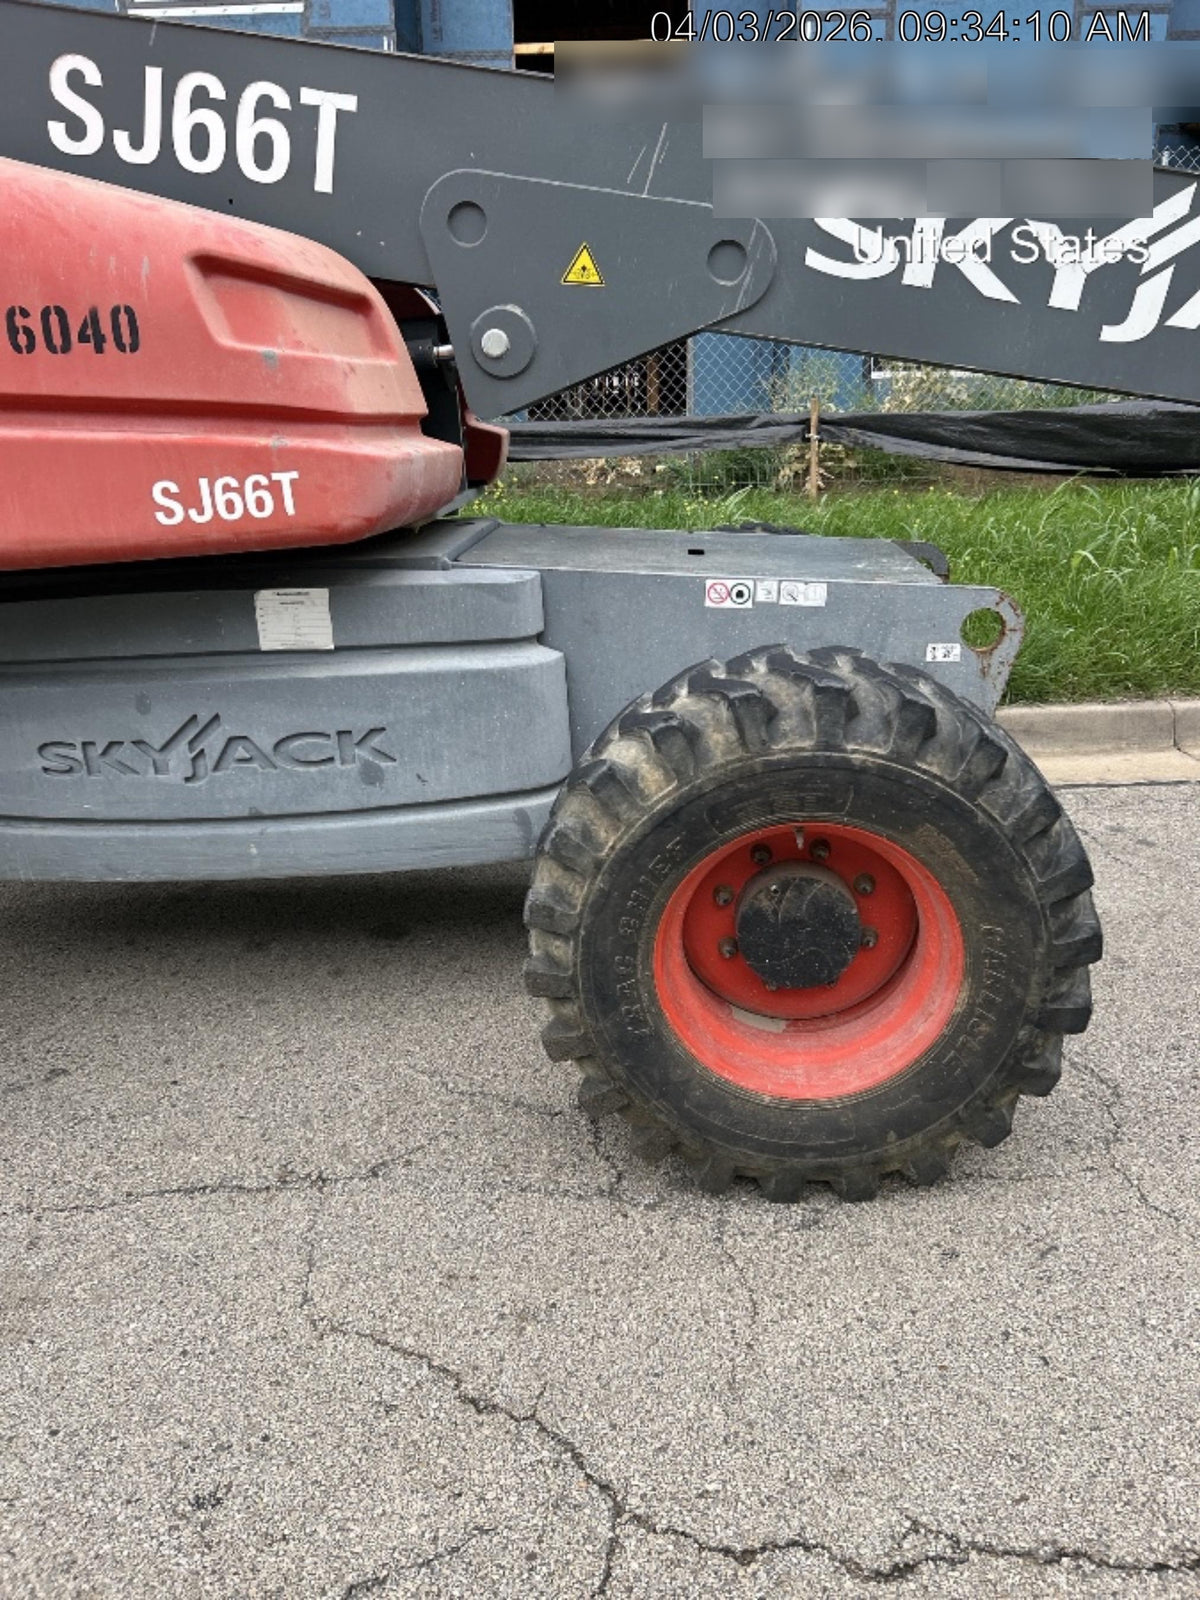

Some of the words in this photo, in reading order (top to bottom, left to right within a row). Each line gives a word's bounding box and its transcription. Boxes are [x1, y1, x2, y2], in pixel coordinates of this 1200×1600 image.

[47, 53, 358, 194] SJ66T
[805, 182, 1200, 342] SKYJ
[6, 305, 140, 354] 6040
[152, 471, 299, 525] SJ66T
[36, 712, 397, 784] SKYJACK
